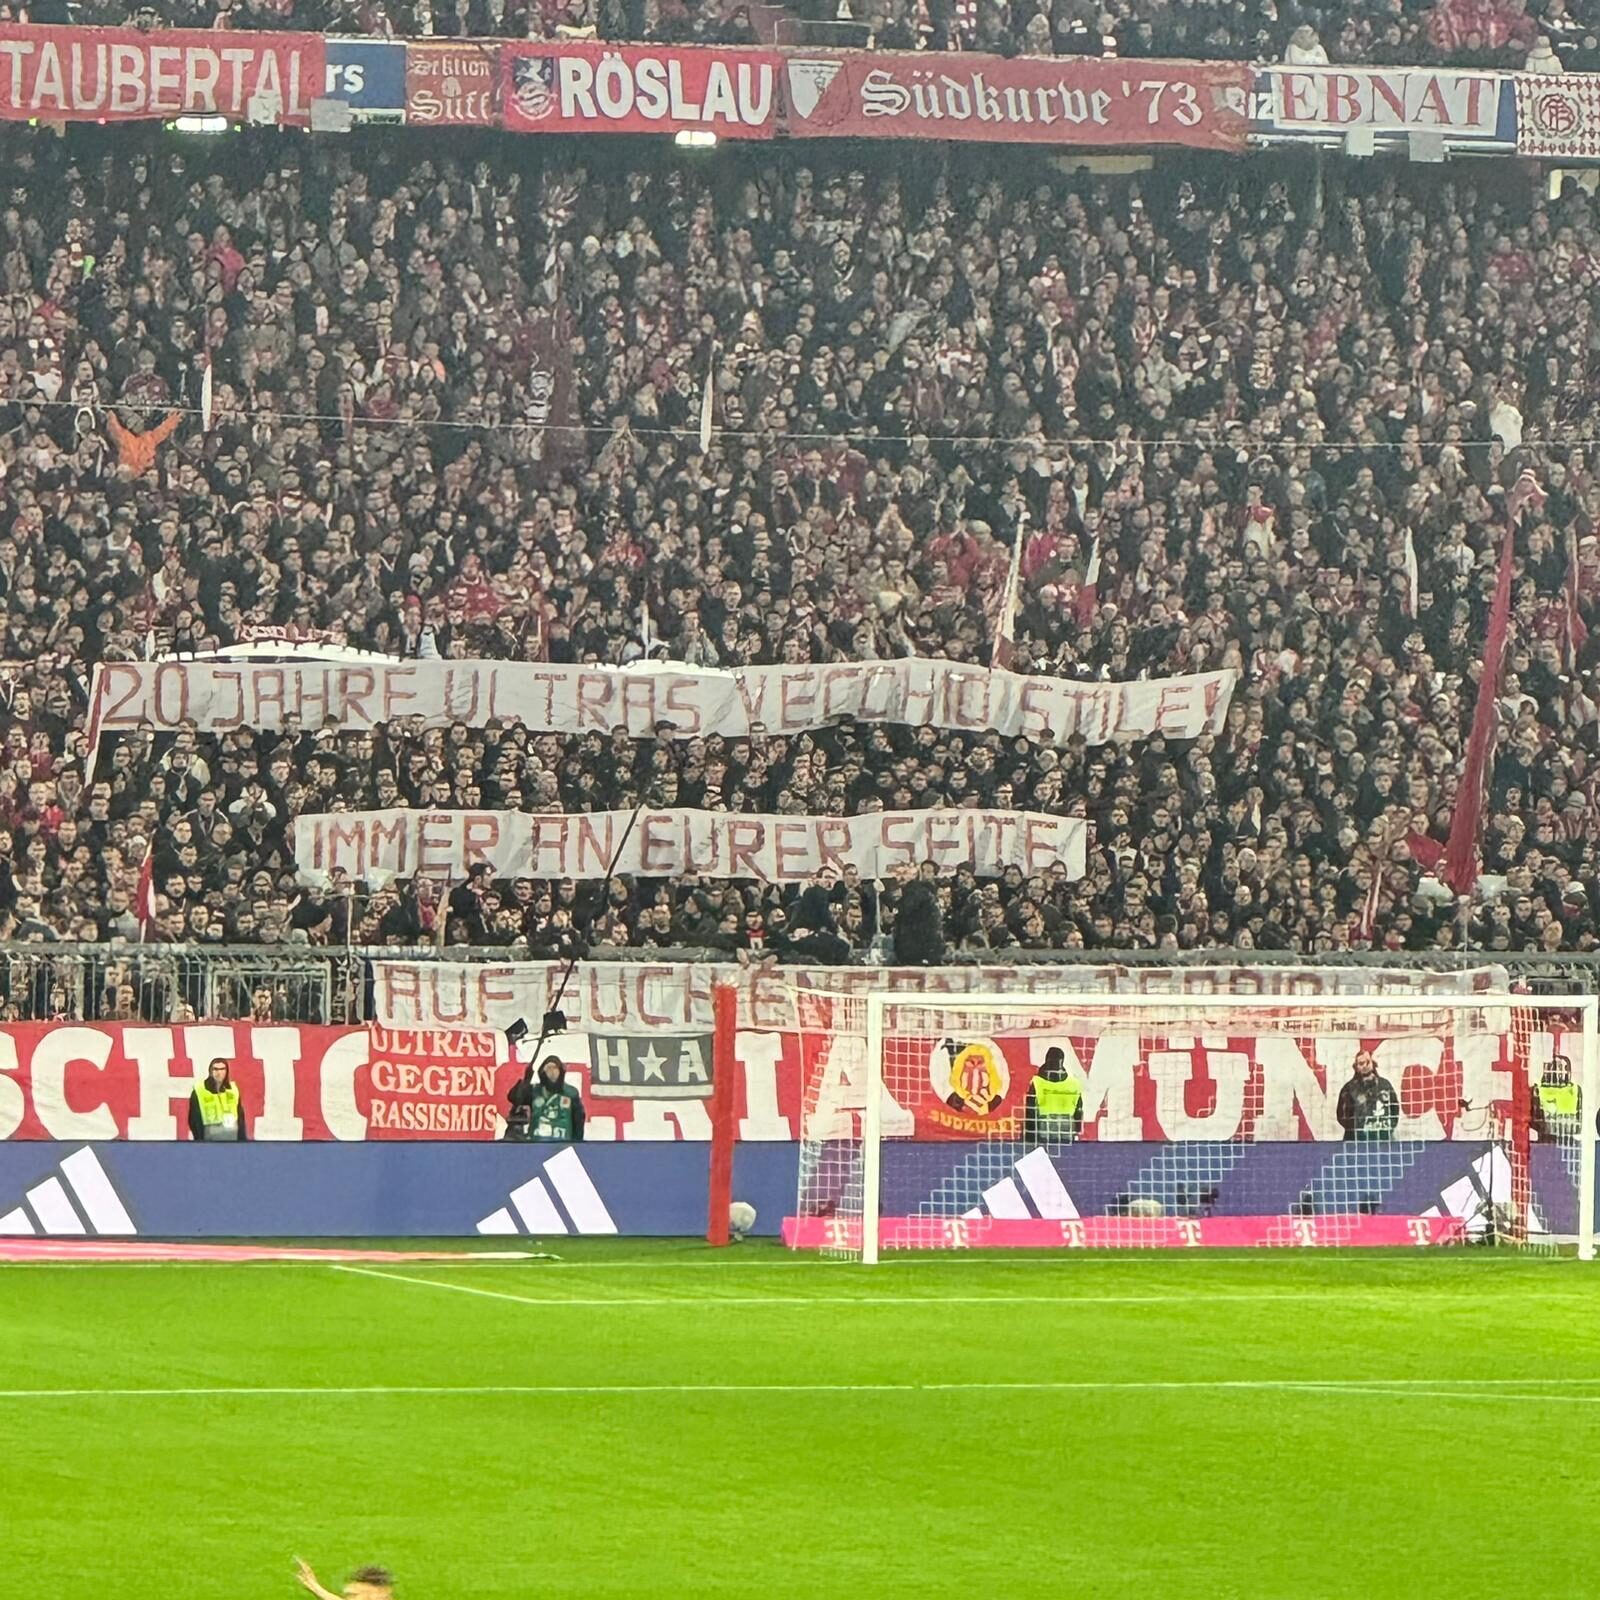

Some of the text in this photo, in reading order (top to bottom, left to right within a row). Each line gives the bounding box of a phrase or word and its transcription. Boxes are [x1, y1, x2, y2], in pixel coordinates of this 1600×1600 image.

[559, 52, 772, 126] RÖSLAU
[861, 69, 1112, 126] Südkurve
[1122, 80, 1203, 127] '73
[1280, 73, 1496, 126] EBNAT
[102, 663, 1222, 743] 20 JAHRE ULTRAS VECCHIO STILE!
[313, 814, 1058, 883] IMMER AN EURER SEITE
[376, 964, 516, 1022] AUF
[546, 963, 717, 1024] EUCH
[370, 1026, 496, 1057] ULTRAS
[370, 1060, 498, 1096] GEGEN
[369, 1099, 498, 1132] RASSISMUS
